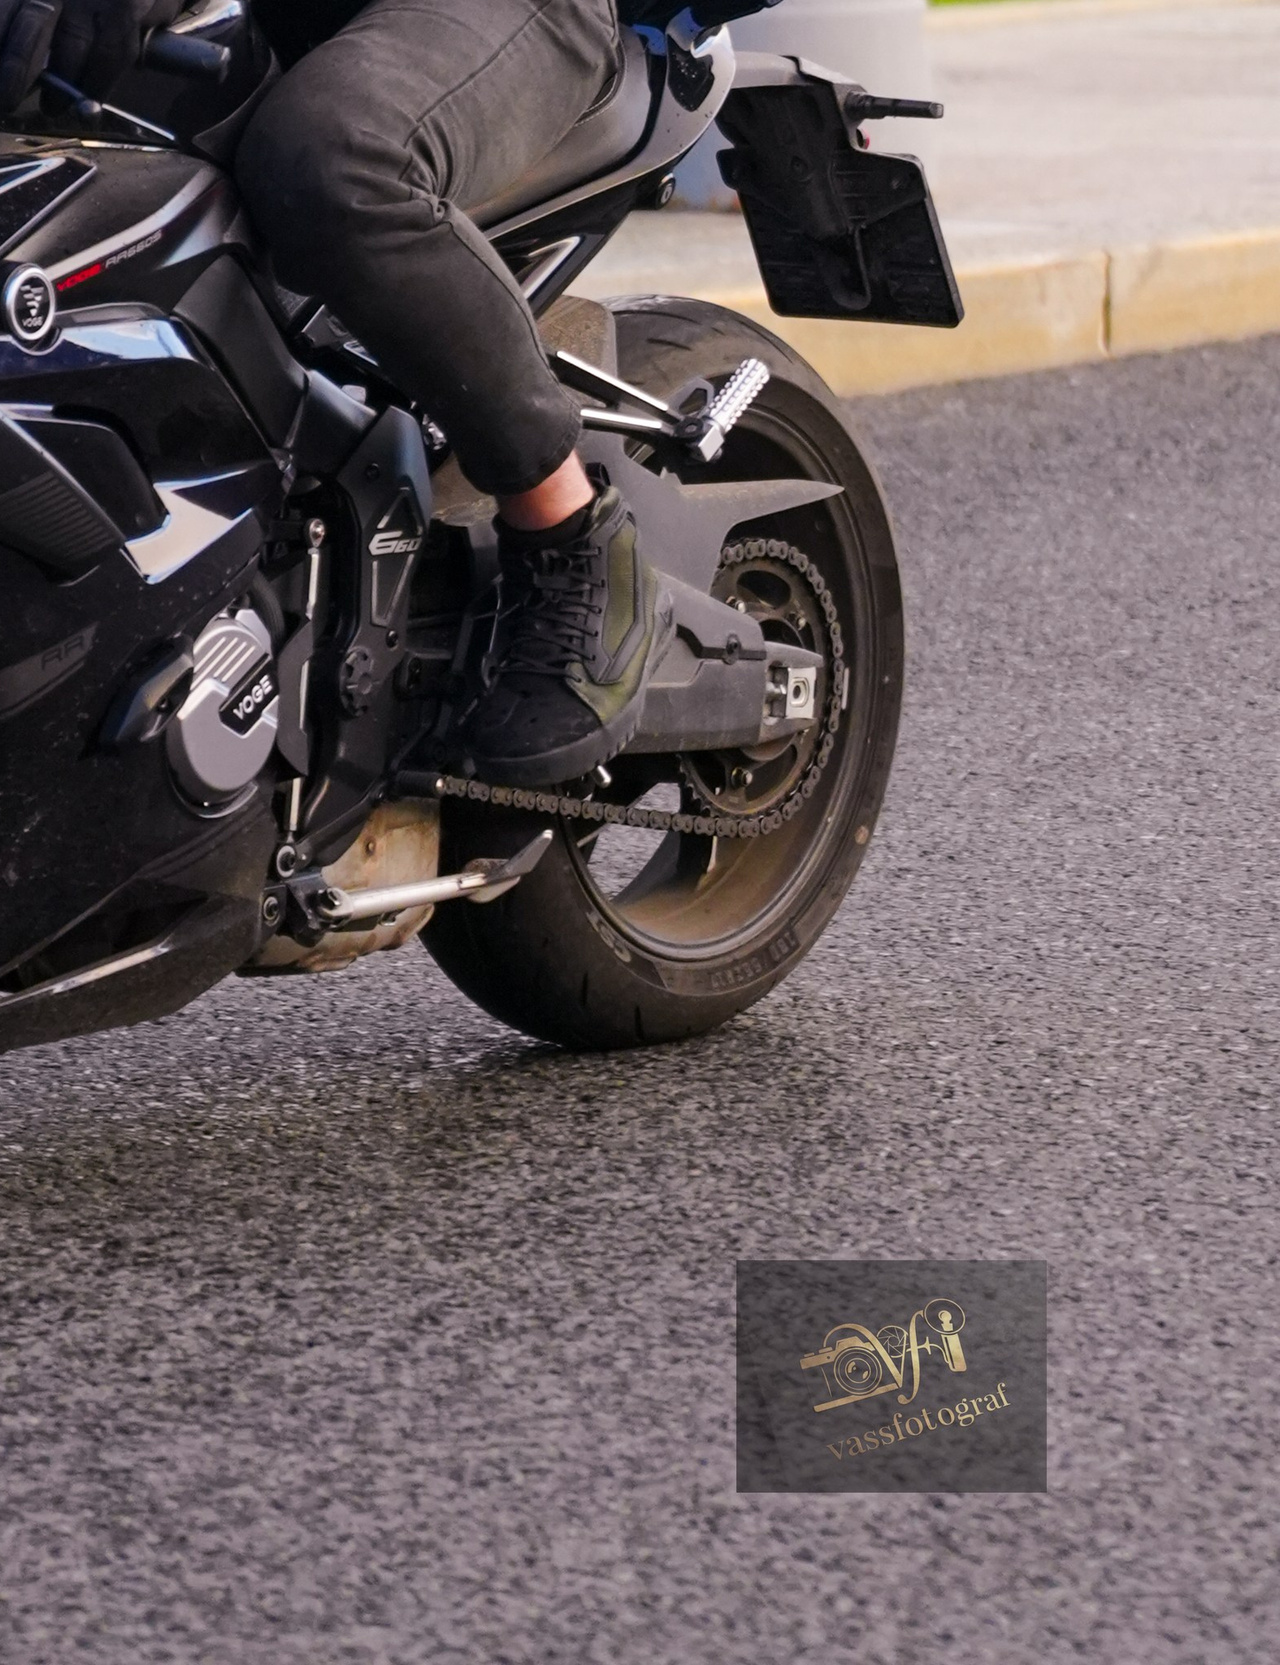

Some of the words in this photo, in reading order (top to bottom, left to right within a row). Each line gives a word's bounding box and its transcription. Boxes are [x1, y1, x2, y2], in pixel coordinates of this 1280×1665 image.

[22, 316, 43, 327] VOGE
[368, 530, 422, 555] 660
[232, 674, 273, 720] VOGE
